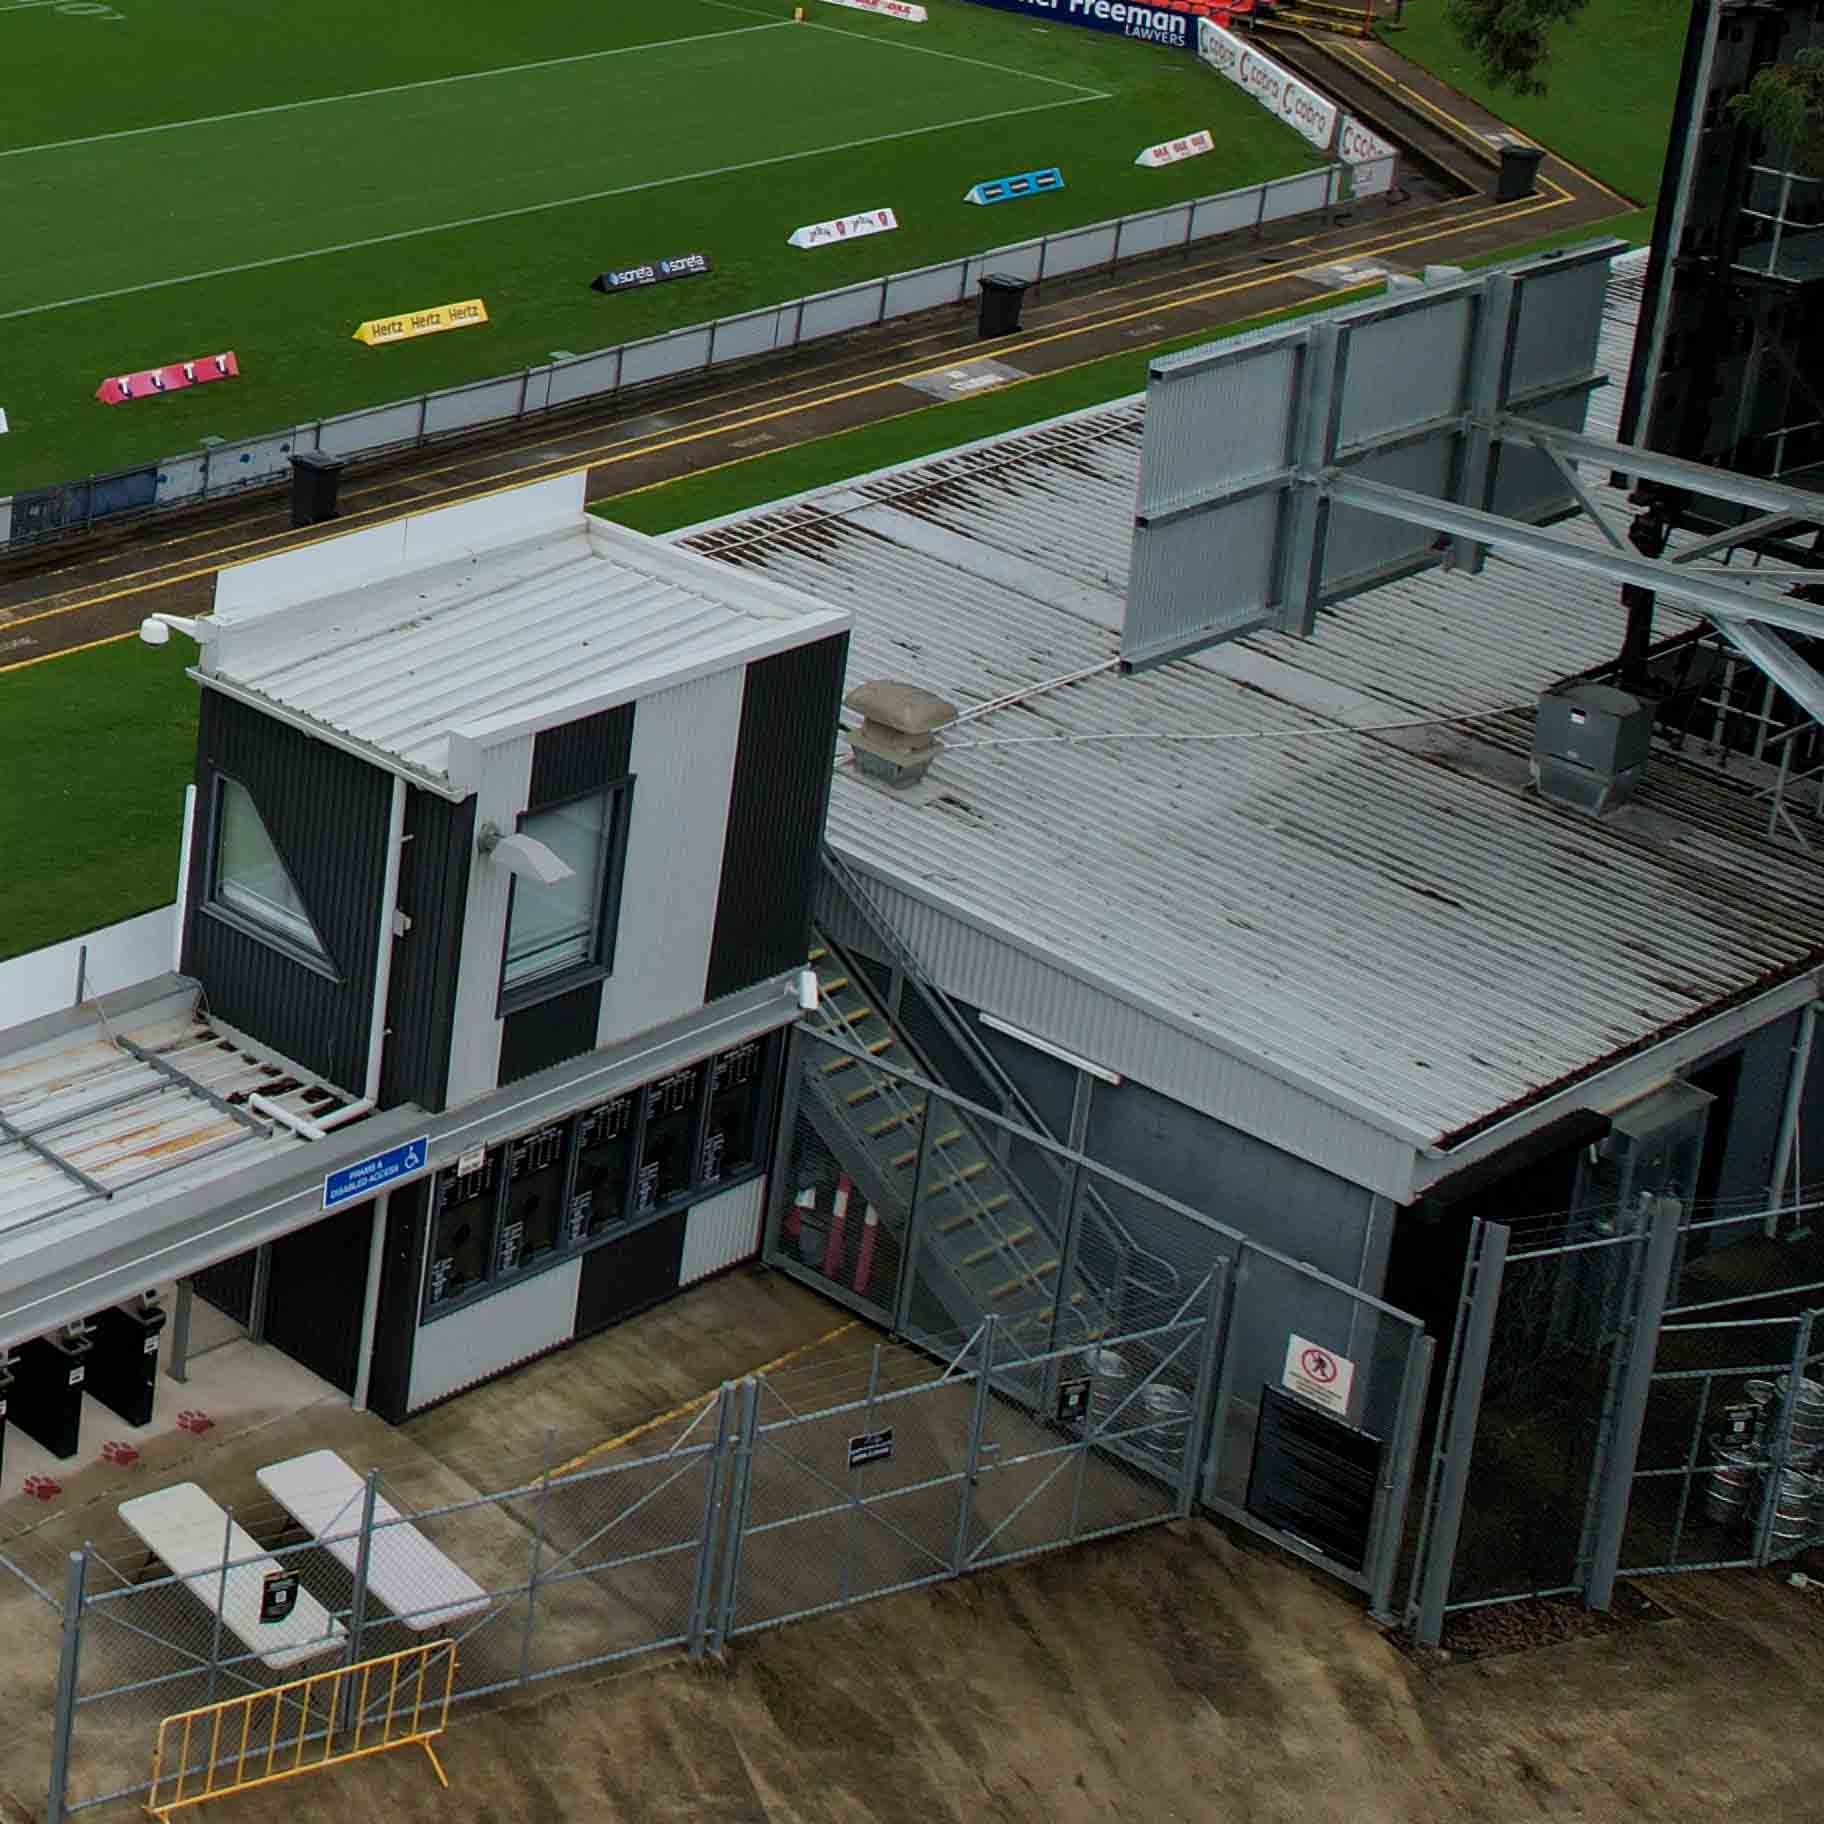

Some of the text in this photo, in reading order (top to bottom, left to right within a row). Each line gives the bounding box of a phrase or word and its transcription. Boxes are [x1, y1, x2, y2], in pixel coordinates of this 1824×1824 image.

[1125, 23, 1185, 47] LAWYERS
[1208, 35, 1326, 132] cobra cobra cobra
[372, 304, 479, 340] Hertz Hertz Hertz
